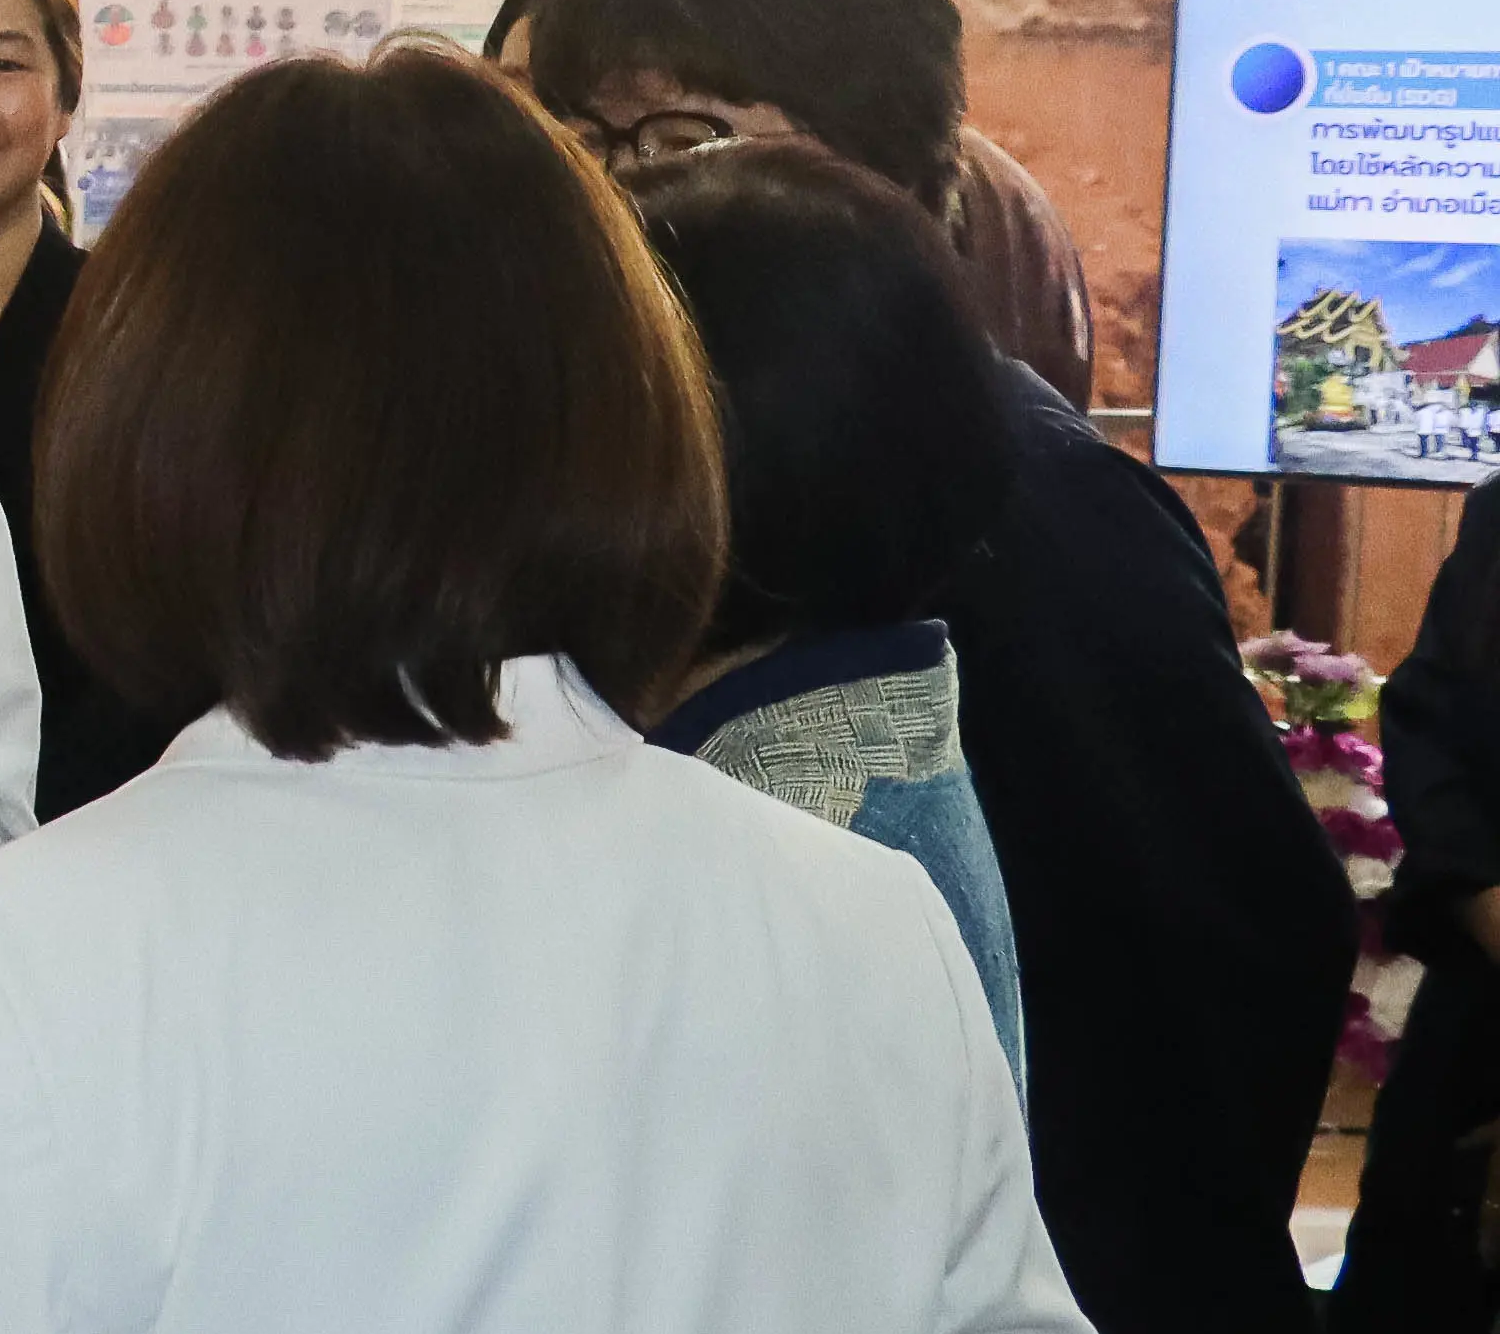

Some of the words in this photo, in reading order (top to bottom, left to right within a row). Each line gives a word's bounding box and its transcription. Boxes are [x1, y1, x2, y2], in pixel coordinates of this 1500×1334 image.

[1311, 117, 1500, 148] การพัฒนารูปแ
